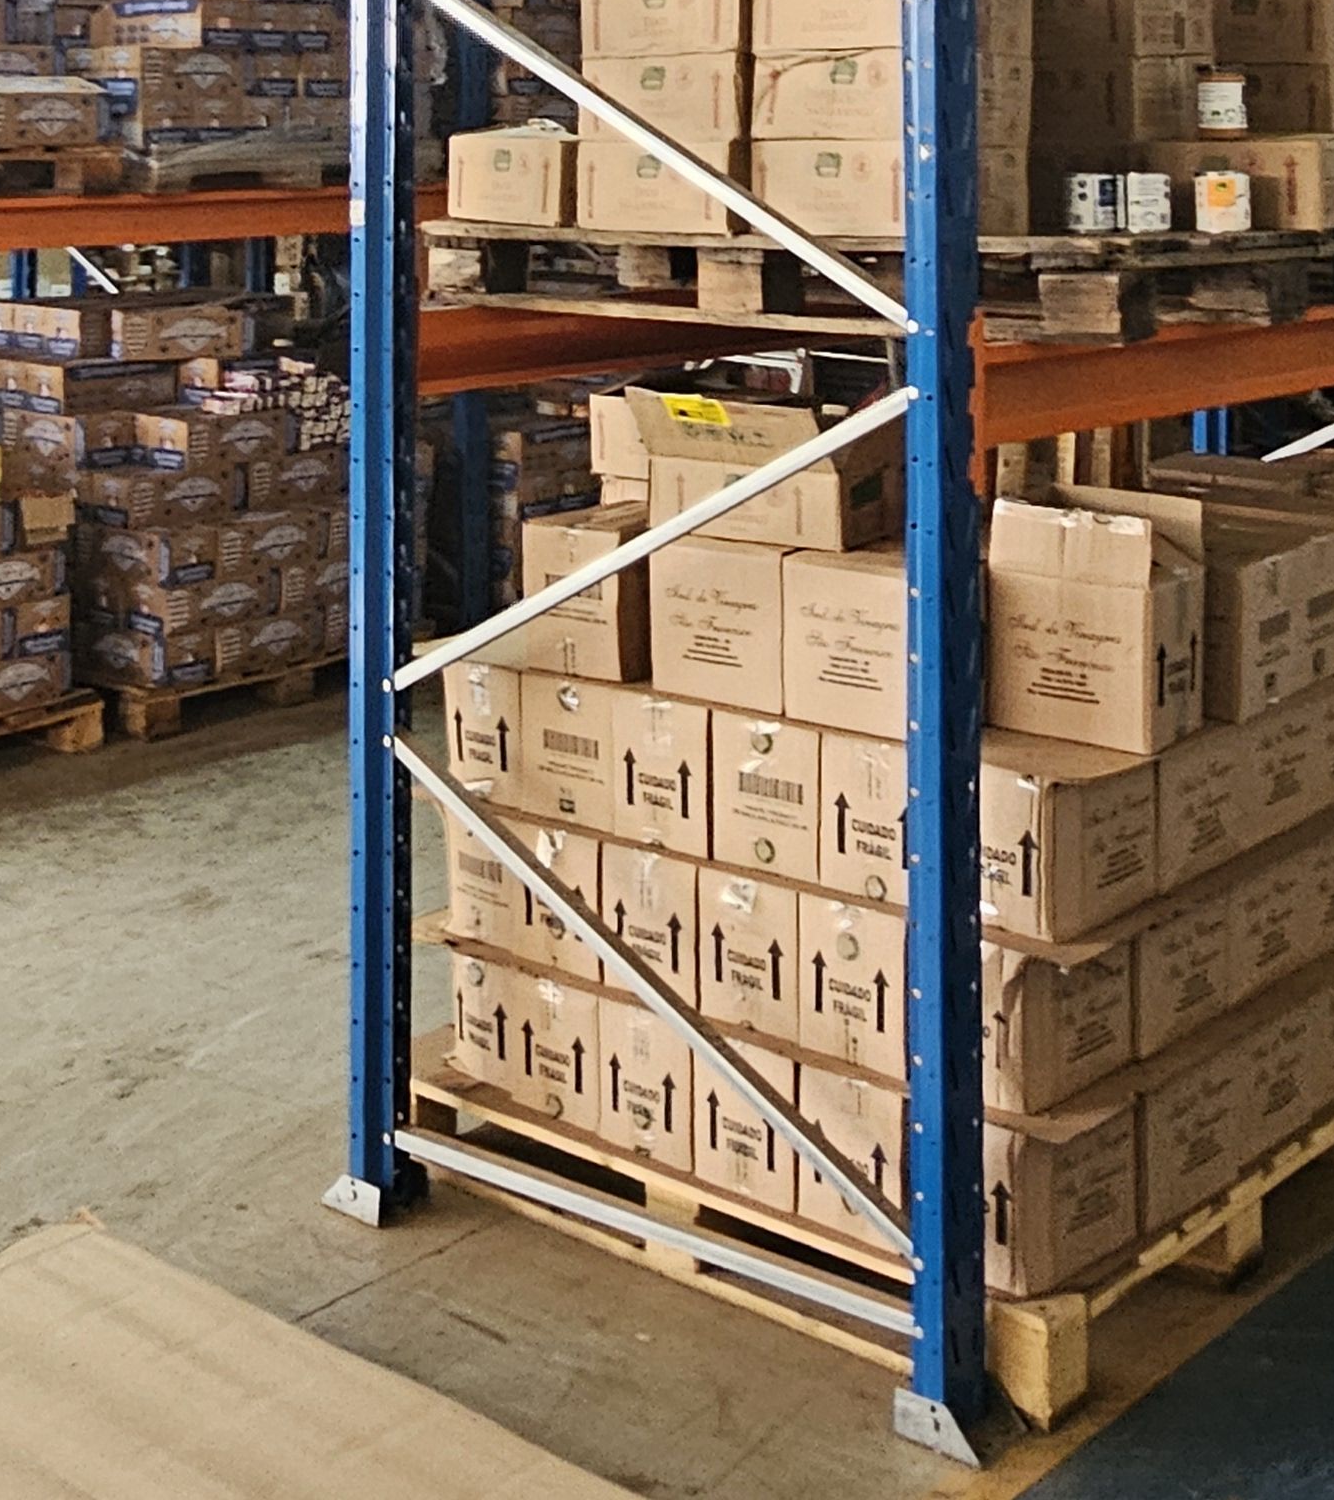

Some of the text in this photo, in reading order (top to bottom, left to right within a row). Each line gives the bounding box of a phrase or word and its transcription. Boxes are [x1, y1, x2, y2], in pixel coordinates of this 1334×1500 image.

[638, 772, 676, 791] CUIDADO
[851, 818, 897, 841] CUIDADO
[628, 925, 666, 945] CUIDADO
[727, 949, 766, 971] CUIDADO
[829, 978, 872, 1002] CUIDADO
[535, 1043, 570, 1067] CUIDADO
[623, 1079, 660, 1104] CUIDADO
[722, 1116, 762, 1141] CUIDADO
